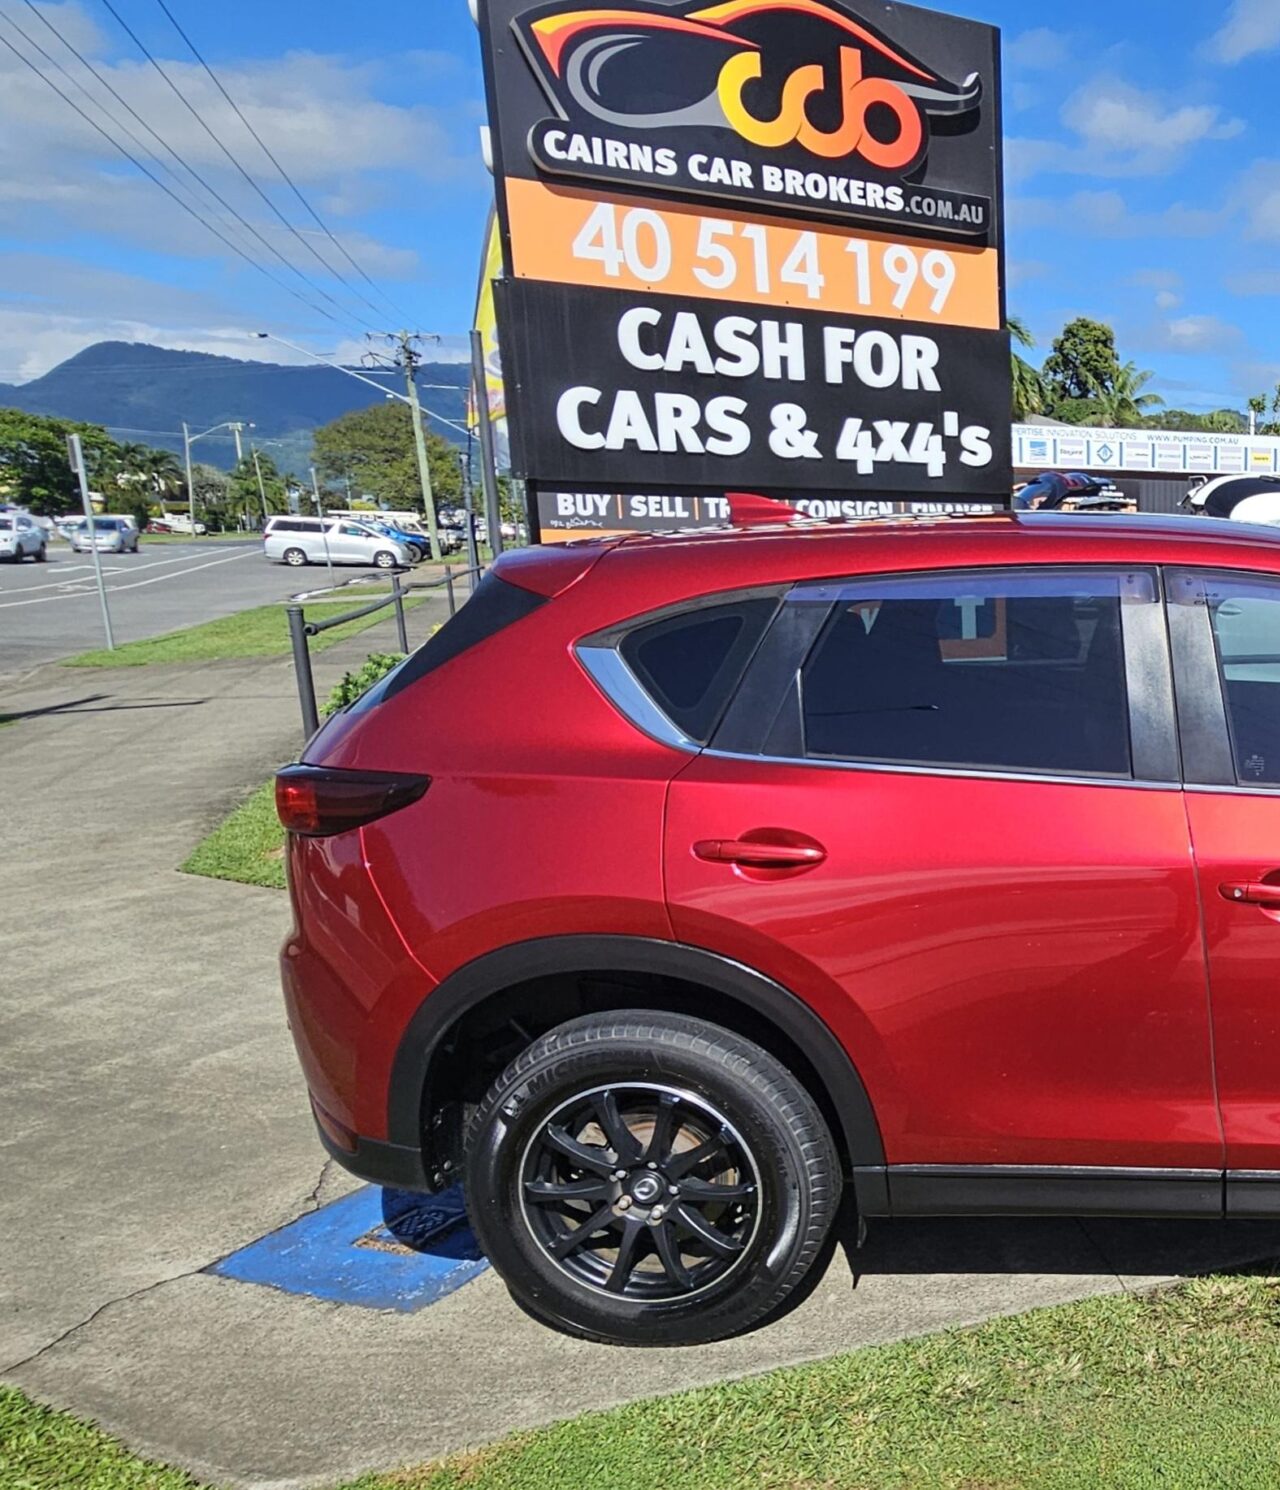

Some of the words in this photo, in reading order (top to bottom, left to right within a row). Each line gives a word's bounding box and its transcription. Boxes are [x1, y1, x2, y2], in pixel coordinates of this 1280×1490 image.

[543, 130, 678, 176] CAIRNS
[688, 154, 754, 188] CAR
[572, 202, 671, 282] 40
[693, 220, 825, 299] 514
[844, 237, 956, 314] 199
[617, 307, 806, 381] CASH
[823, 327, 942, 392] FOR
[556, 387, 751, 456] CARS
[768, 402, 823, 459] &
[556, 493, 611, 517] BUY
[630, 495, 689, 518] SELL
[796, 499, 894, 518] CONSIGN
